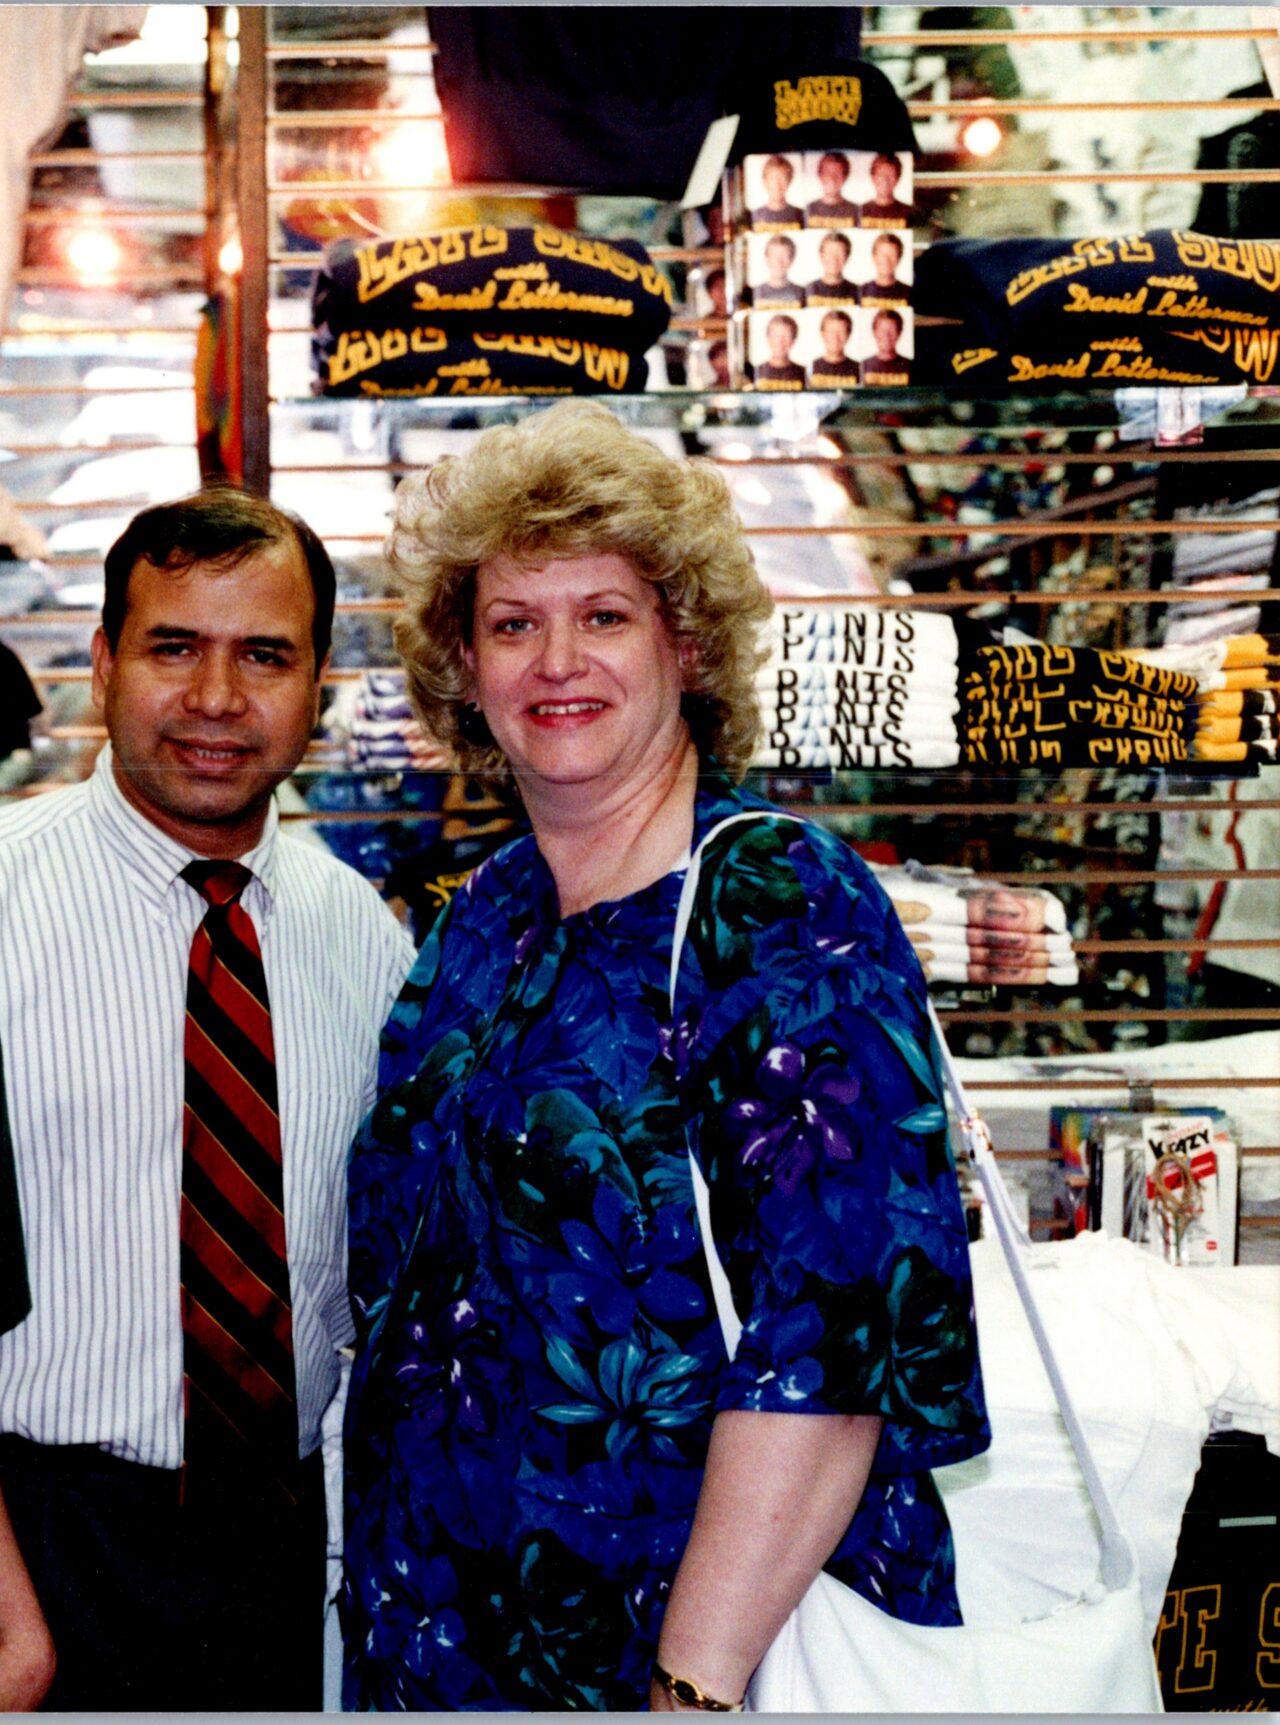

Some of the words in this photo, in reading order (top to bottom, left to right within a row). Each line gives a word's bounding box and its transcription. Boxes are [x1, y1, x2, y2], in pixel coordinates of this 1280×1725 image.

[774, 76, 862, 99] LATE
[775, 97, 862, 130] SHOW
[493, 262, 549, 281] with
[1147, 274, 1199, 292] with
[413, 280, 497, 311] David
[498, 280, 634, 317] Letterman
[1063, 282, 1148, 314] David
[1147, 290, 1269, 326] Letterman
[1090, 338, 1143, 353] with
[437, 358, 490, 377] with
[1007, 352, 1091, 382] David
[1091, 353, 1219, 384] Letterman
